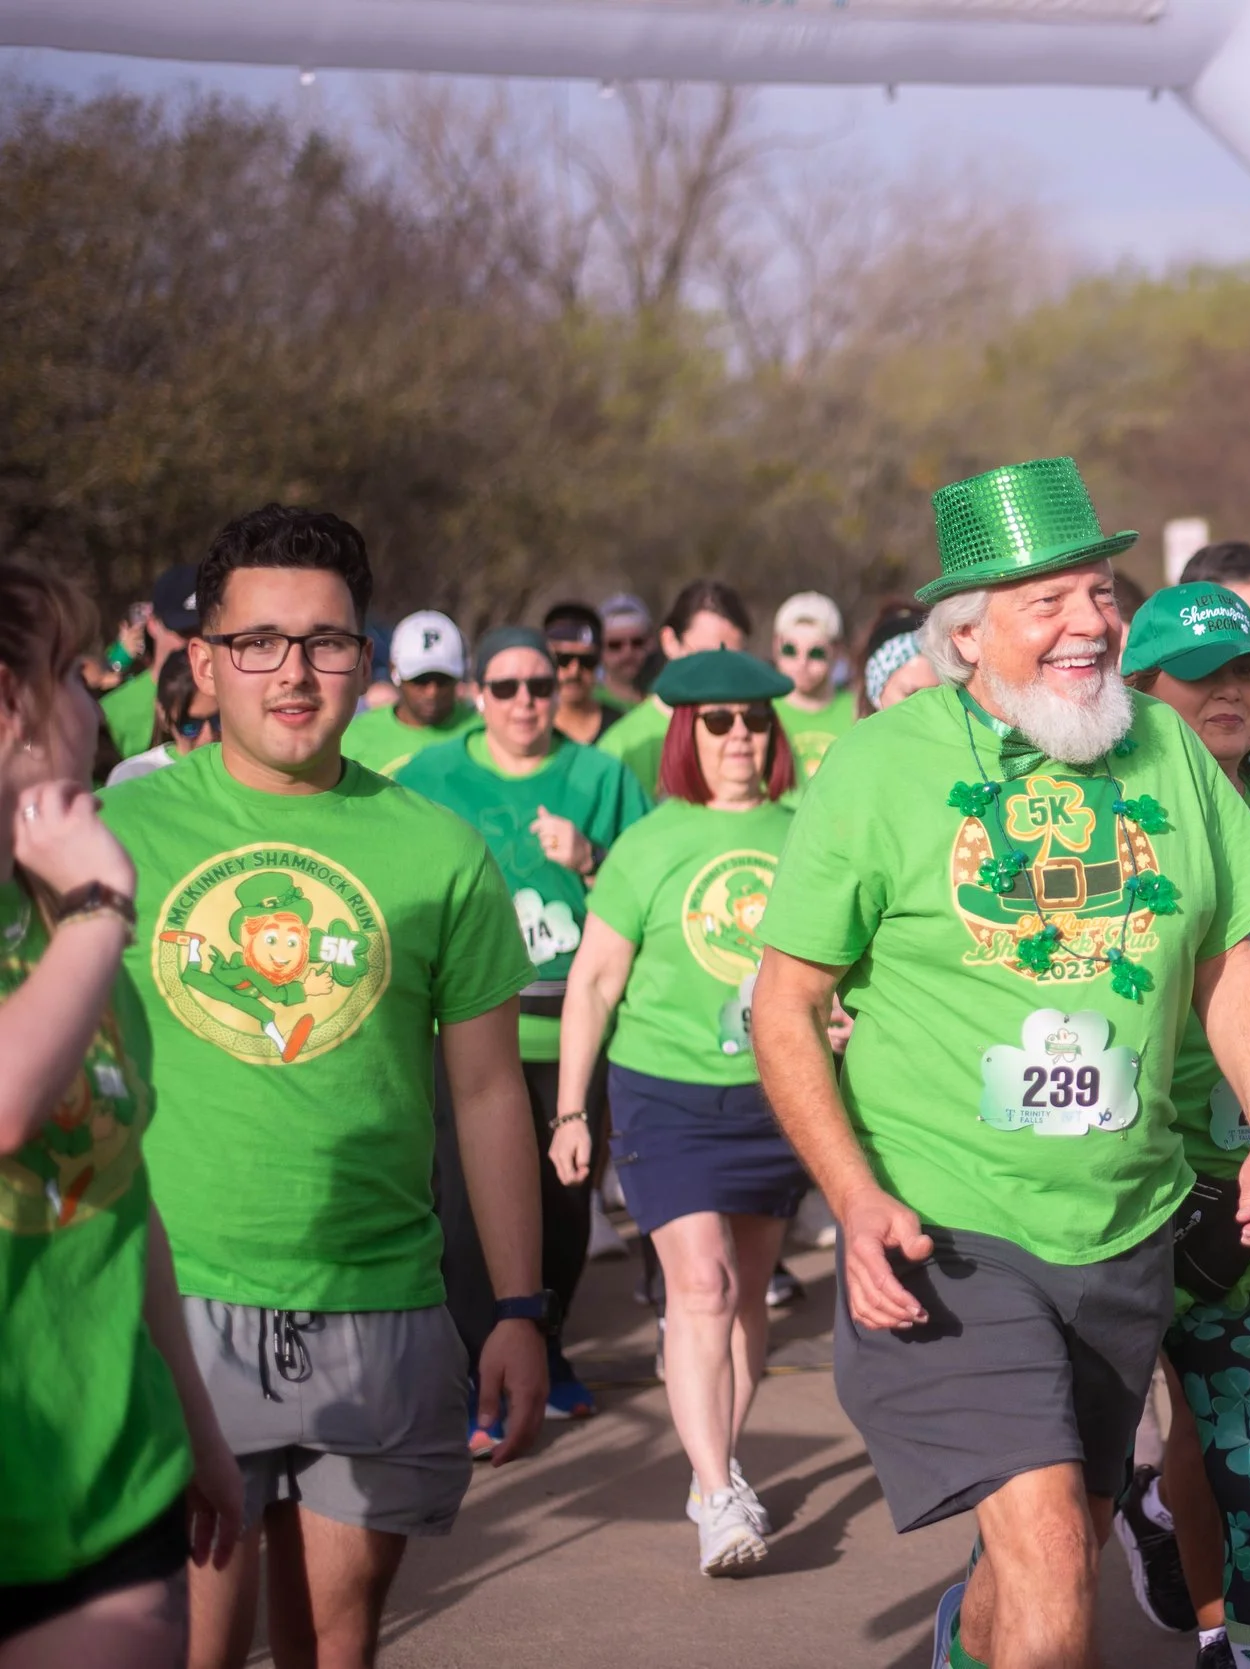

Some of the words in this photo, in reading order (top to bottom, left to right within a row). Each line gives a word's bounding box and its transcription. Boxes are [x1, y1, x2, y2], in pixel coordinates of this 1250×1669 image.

[1028, 795, 1074, 826] 5K
[167, 857, 247, 927] MCKINNEY
[252, 851, 351, 894] SHAMROCK
[350, 893, 376, 930] RUN
[319, 935, 358, 966] 5K
[1036, 960, 1096, 981] 2023
[1022, 1065, 1100, 1108] 239
